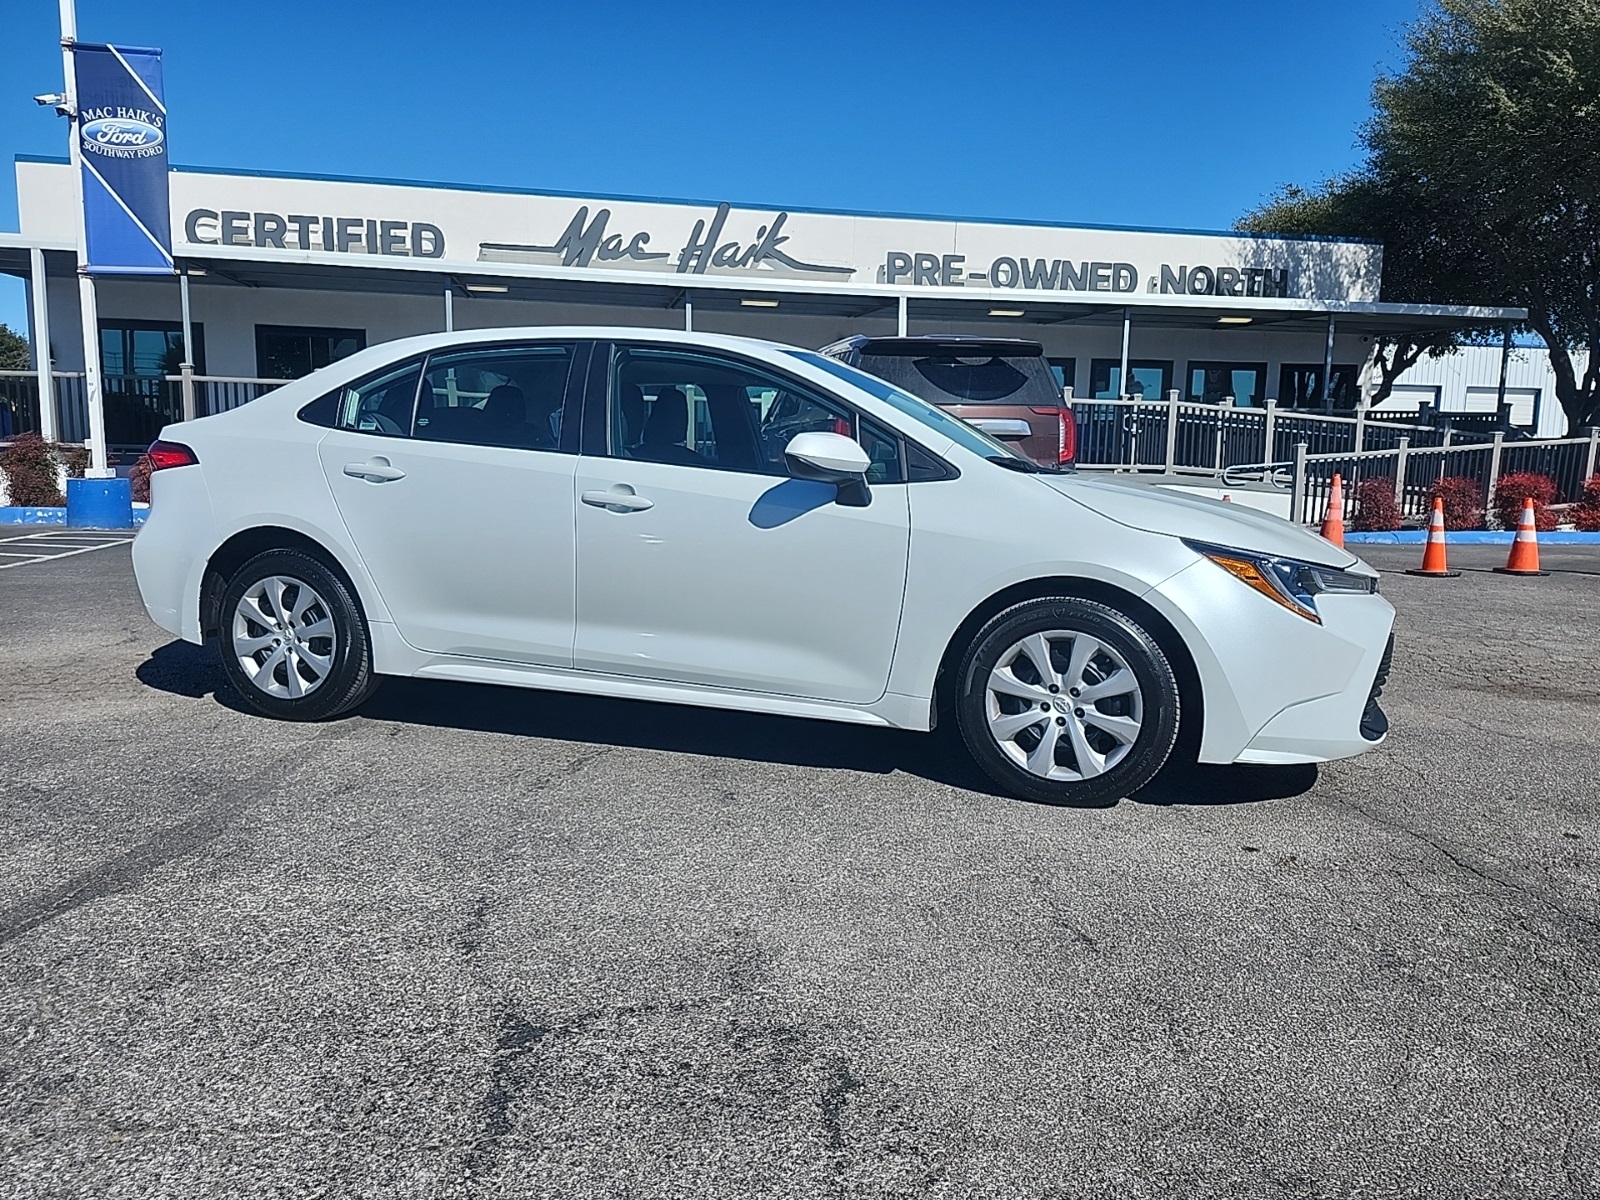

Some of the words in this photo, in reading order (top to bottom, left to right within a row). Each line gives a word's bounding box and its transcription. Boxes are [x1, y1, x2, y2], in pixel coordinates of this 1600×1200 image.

[81, 106, 113, 122] MAC
[116, 106, 163, 128] HAIK'S
[96, 122, 148, 144] Ford
[82, 141, 136, 159] SOUTHWAY
[136, 145, 163, 158] FORD
[185, 209, 446, 259] CERTIFIED
[479, 206, 670, 267] Mac
[676, 202, 857, 274] Haik
[886, 252, 1139, 294] PRE-OWNED
[1159, 264, 1288, 299] NORTH
